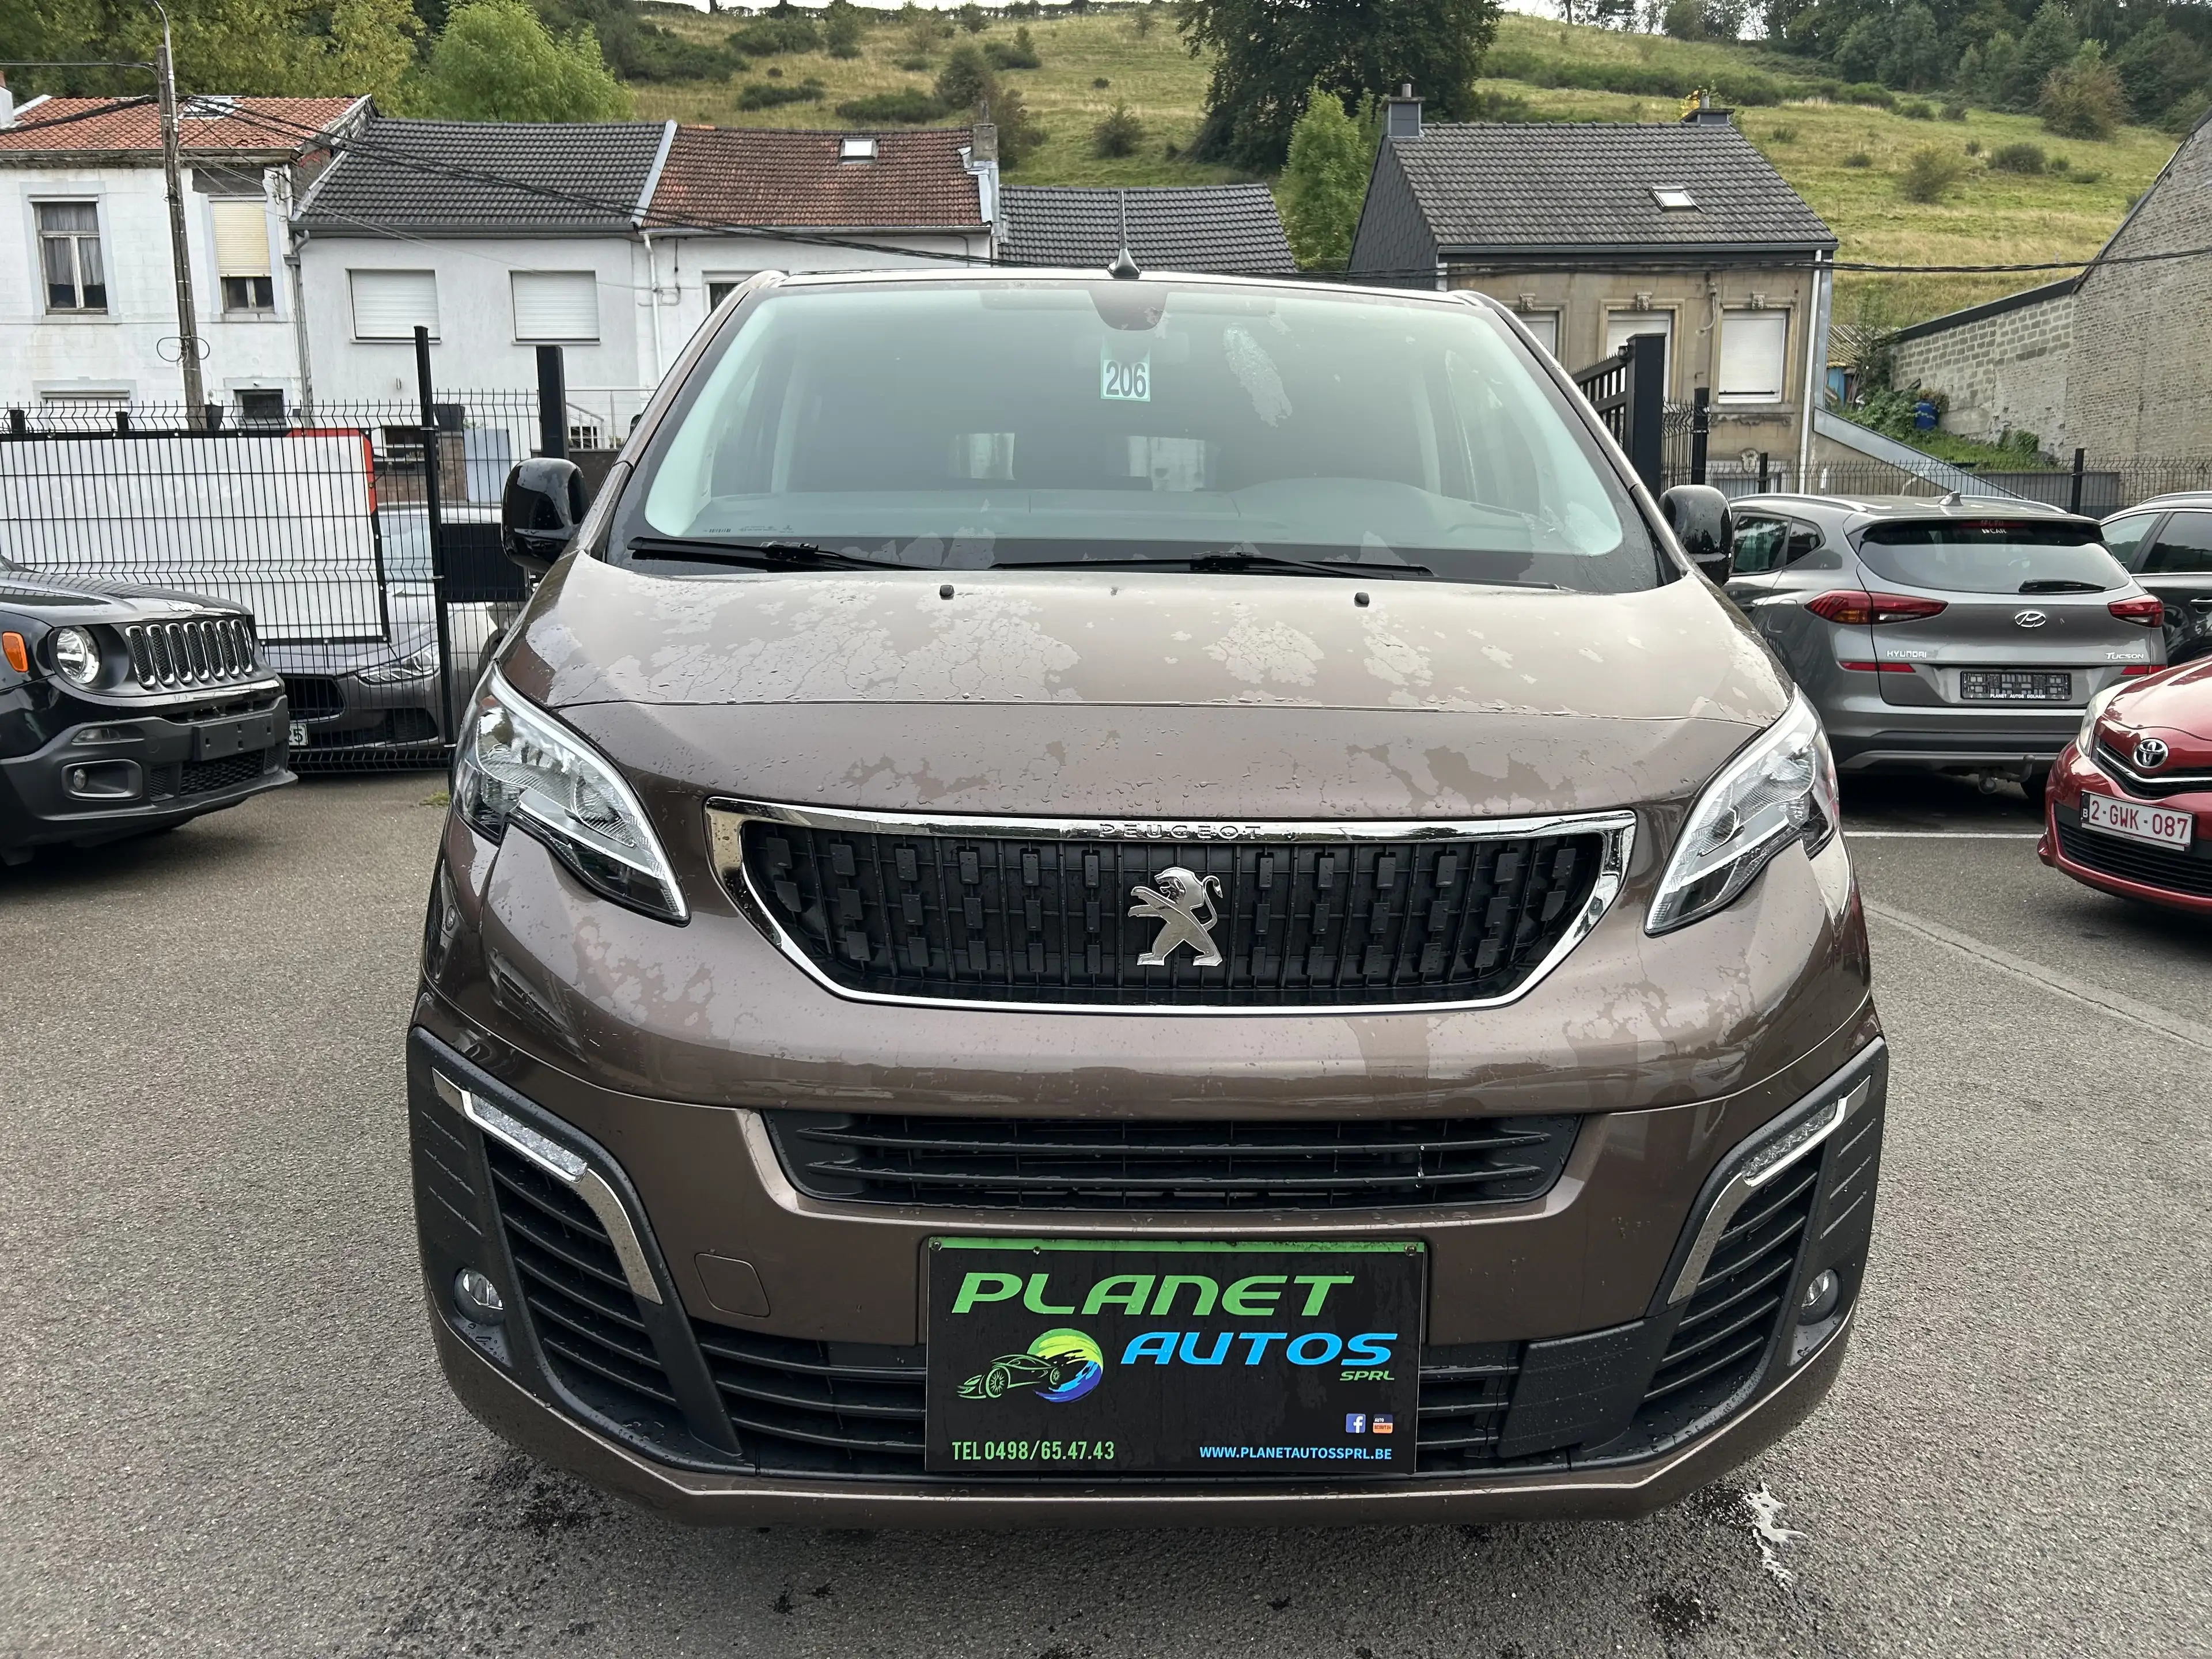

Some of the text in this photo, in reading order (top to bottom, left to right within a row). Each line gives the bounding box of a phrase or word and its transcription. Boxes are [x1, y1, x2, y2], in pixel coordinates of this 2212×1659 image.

[1106, 361, 1146, 397] 206
[1099, 823, 1261, 839] PEUGEOT
[2091, 800, 2189, 839] 2-GWK-087
[952, 1272, 1355, 1316] PLANET
[1120, 1331, 1398, 1366] AUTOS
[1339, 1370, 1395, 1381] SPRL
[952, 1440, 1115, 1460] TEL 0498/65.47.43
[1199, 1446, 1392, 1460] WWW.PLANETAUTOSSPRL.BE
